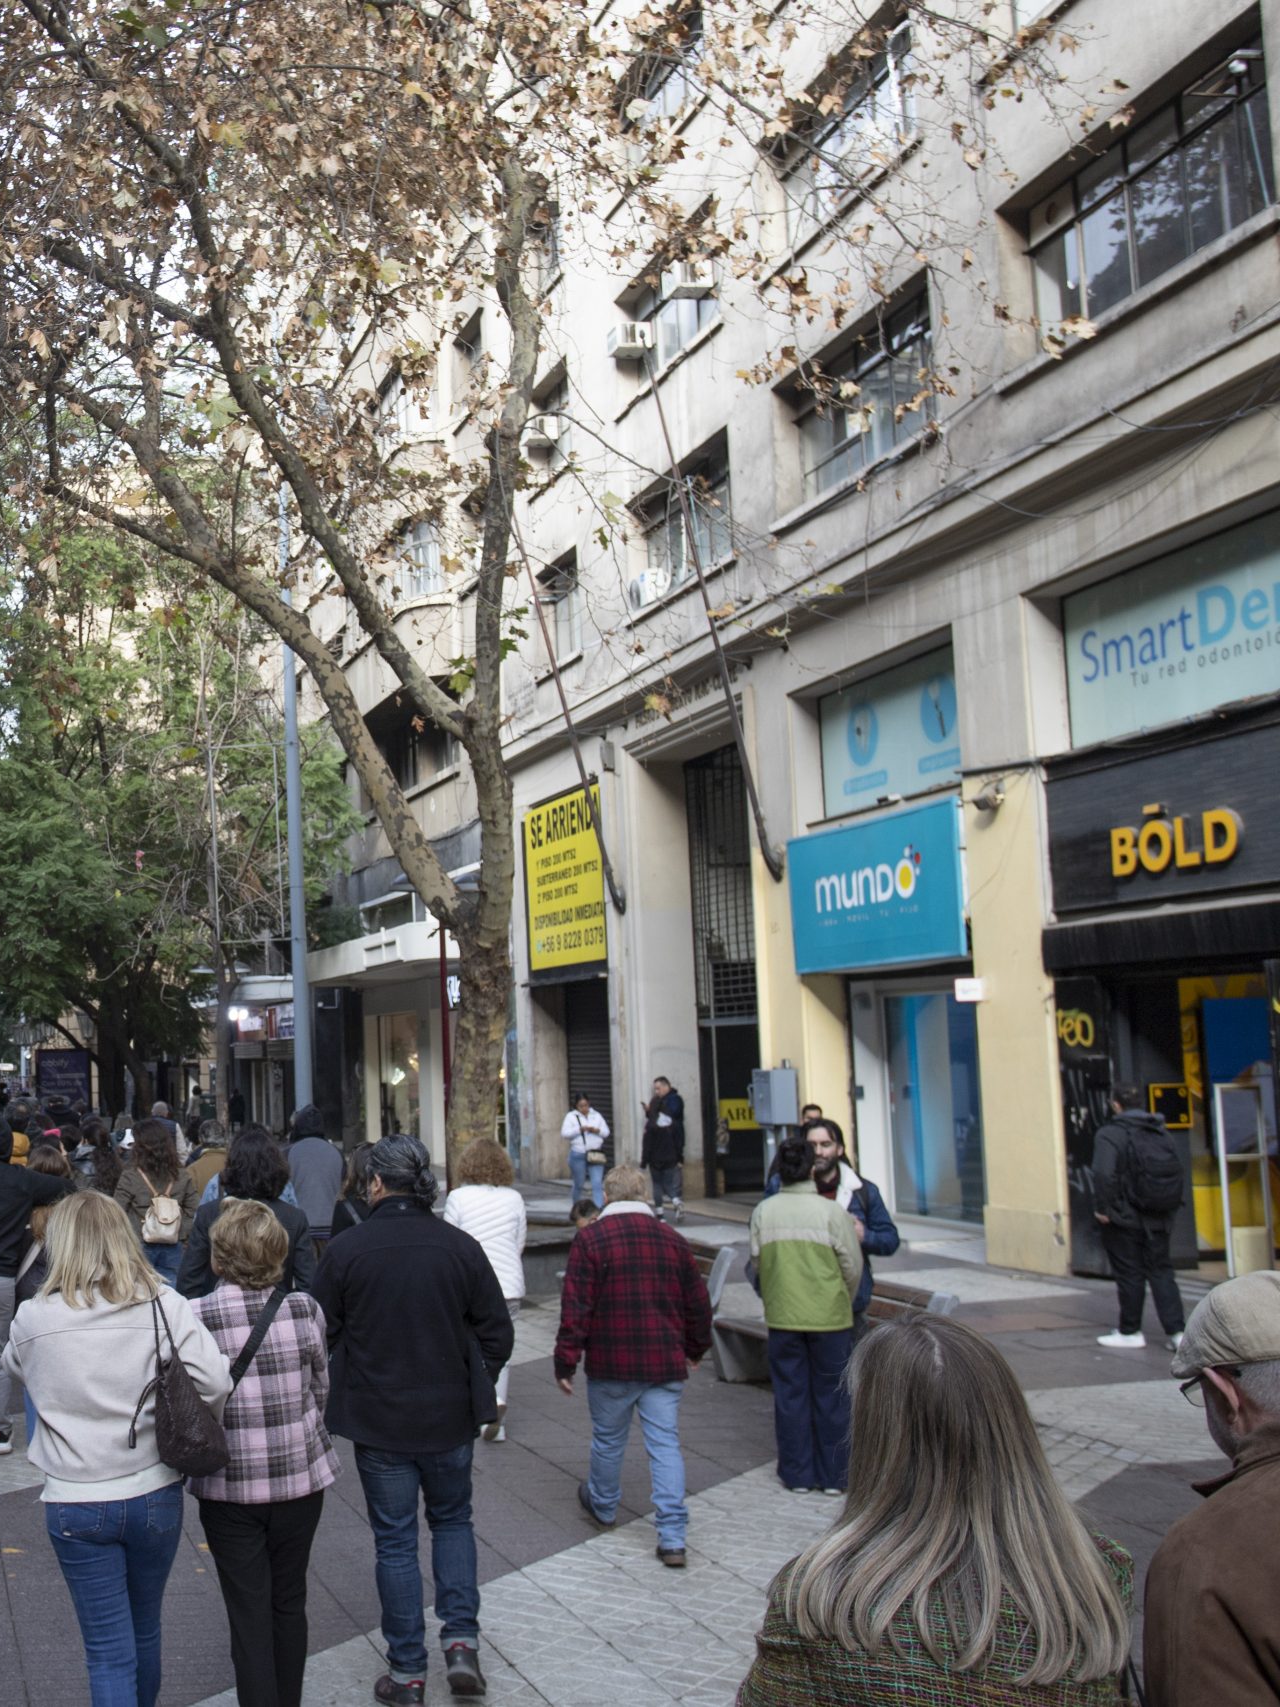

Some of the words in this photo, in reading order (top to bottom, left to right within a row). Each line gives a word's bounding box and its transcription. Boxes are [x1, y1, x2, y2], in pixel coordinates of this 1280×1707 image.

[1130, 670, 1149, 687] Tu
[1159, 657, 1188, 679] red
[530, 813, 543, 850] SE
